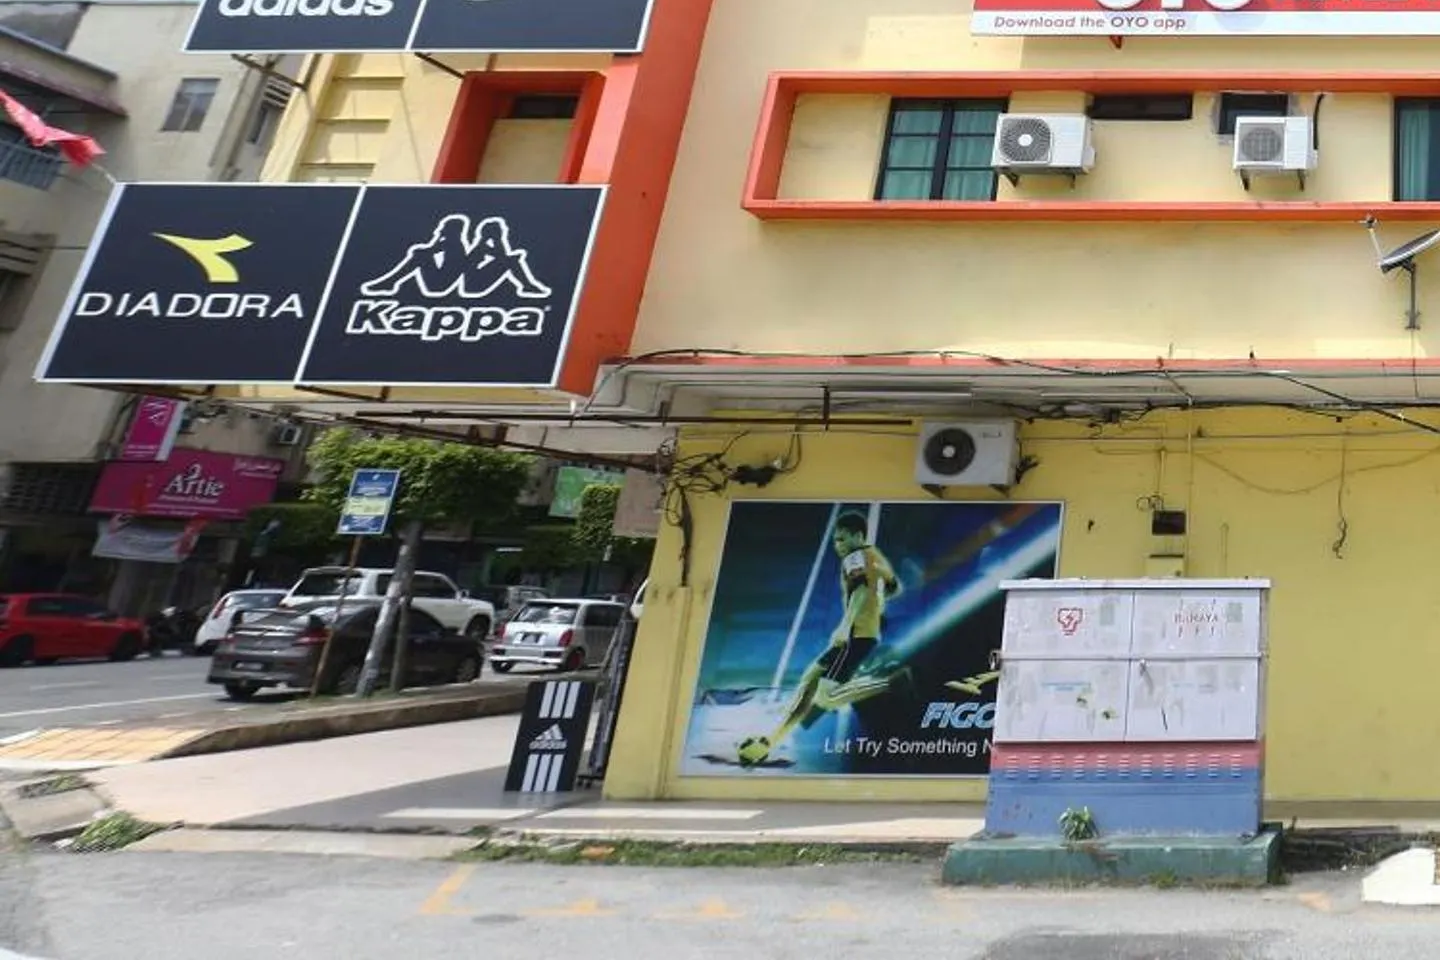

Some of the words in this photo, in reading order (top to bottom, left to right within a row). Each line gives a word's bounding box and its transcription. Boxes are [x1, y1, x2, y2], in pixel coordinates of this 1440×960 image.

[993, 16, 1077, 28] Download
[1080, 16, 1106, 28] the
[1110, 16, 1149, 28] OYO
[1153, 17, 1187, 30] app
[75, 292, 305, 318] DIADORA
[345, 301, 545, 341] Kappa
[824, 738, 850, 754] Let
[856, 738, 883, 757] Try
[887, 738, 977, 757] Something
